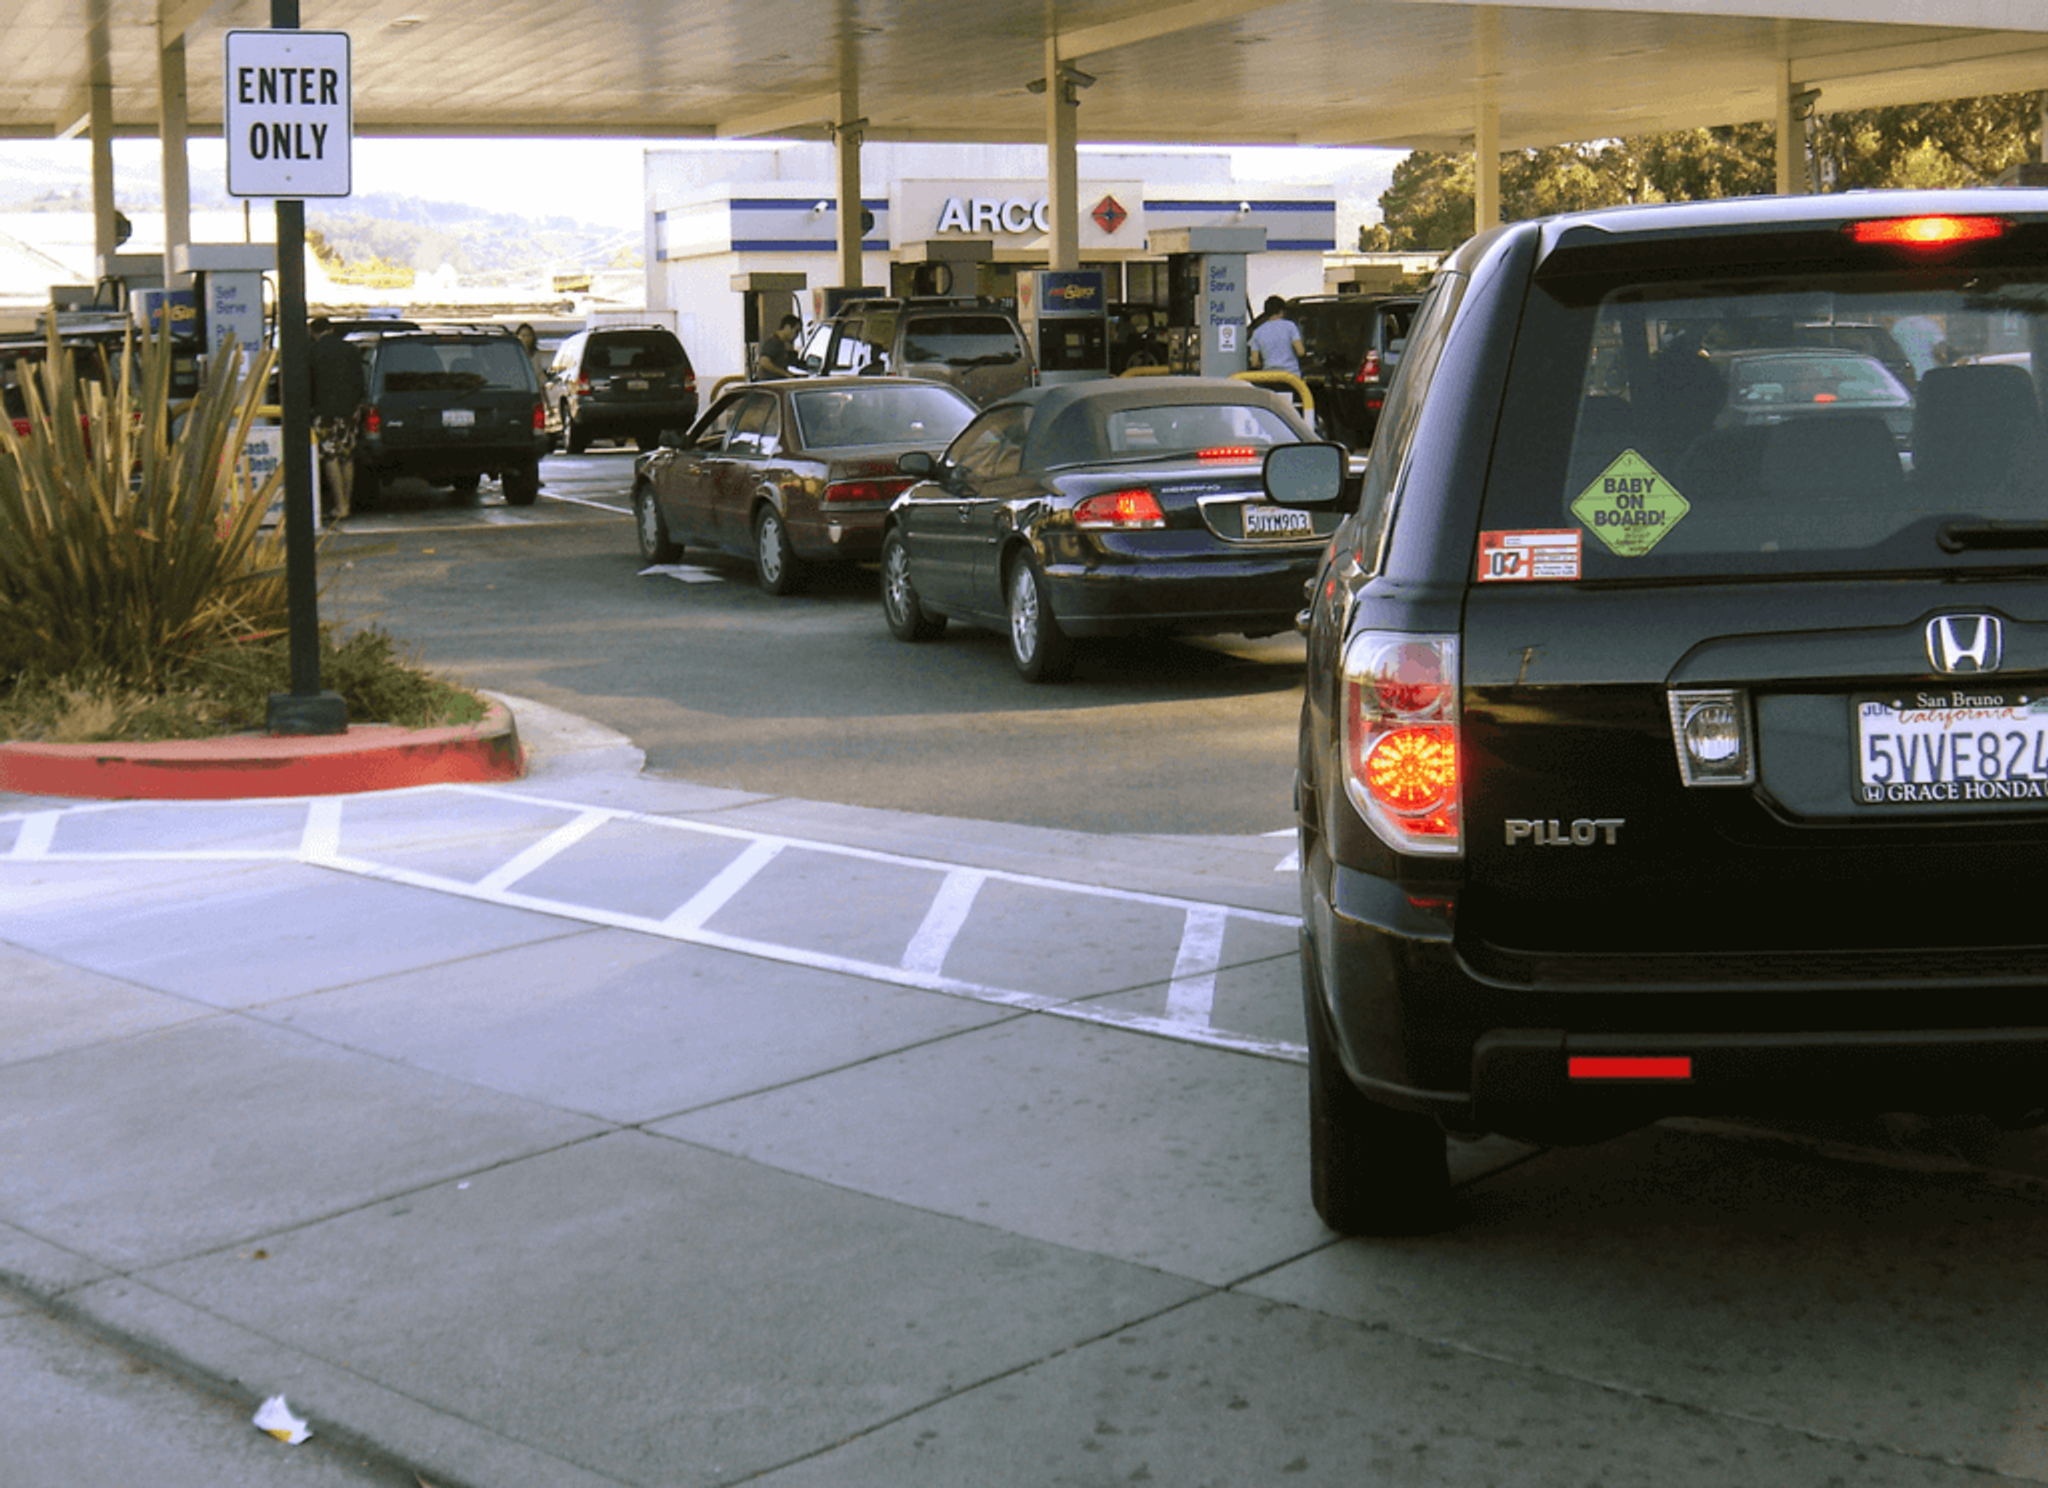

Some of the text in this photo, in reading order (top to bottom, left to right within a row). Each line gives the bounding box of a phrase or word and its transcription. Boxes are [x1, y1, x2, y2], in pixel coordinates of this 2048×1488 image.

[238, 67, 338, 105] ENTER
[249, 122, 328, 160] ONLY
[1210, 266, 1227, 279] Self
[215, 286, 237, 299] Self
[1210, 280, 1235, 292] Serve
[216, 301, 247, 314] Serve
[1603, 478, 1655, 493] BABY
[1616, 494, 1644, 509] ON
[1248, 513, 1307, 532] 5UYM903
[1594, 510, 1666, 526] BOARD!
[1492, 552, 1519, 576] 07
[1916, 691, 2003, 707] San Bruno
[1862, 704, 1893, 716] JUL
[1898, 707, 2028, 730] California
[1869, 730, 2048, 784] 5VVE824
[1888, 781, 2043, 801] GRACE HONDA
[1505, 818, 1626, 846] PILOT
